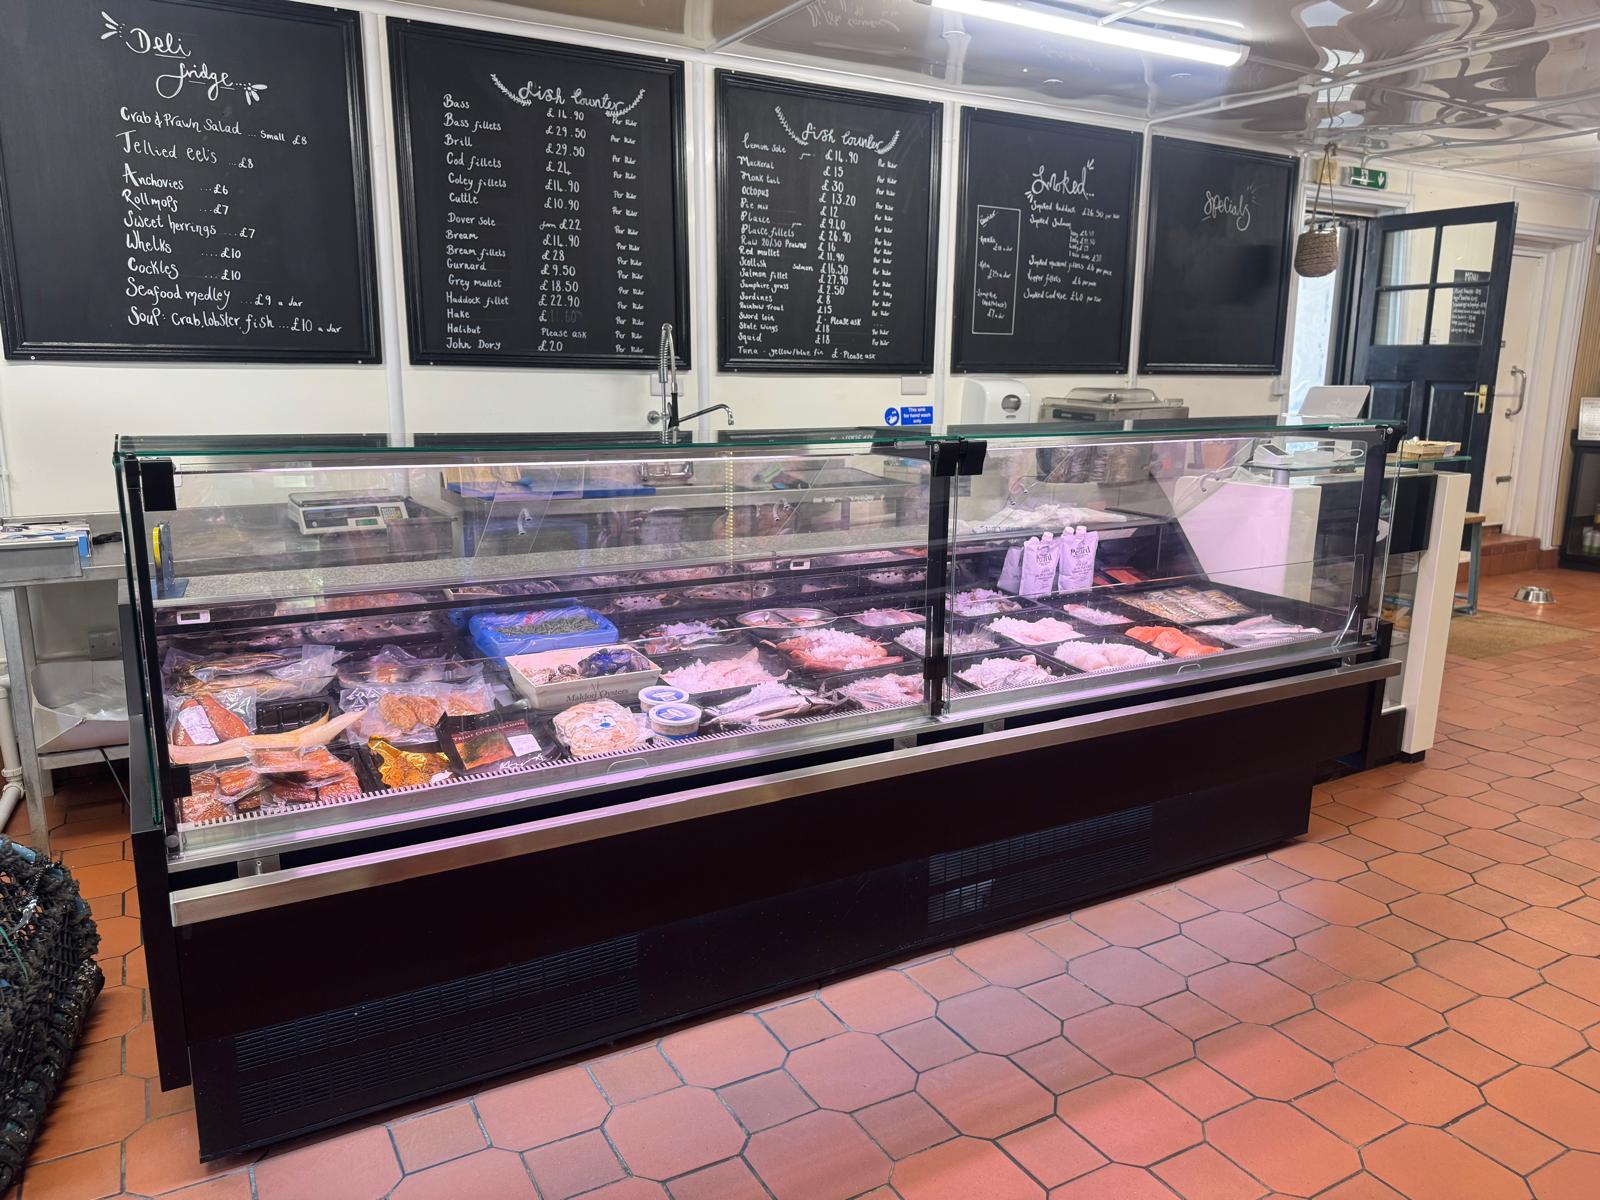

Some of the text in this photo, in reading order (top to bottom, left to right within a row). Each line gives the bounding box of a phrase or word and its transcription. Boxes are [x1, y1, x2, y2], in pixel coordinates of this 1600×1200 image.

[126, 28, 191, 56] Deli
[443, 94, 469, 109] Bass
[121, 107, 151, 123] Crab
[163, 113, 201, 132] Prawn
[203, 119, 242, 134] Salad
[292, 135, 307, 145] £8
[443, 112, 469, 127] Bass
[472, 121, 501, 132] fillets
[116, 130, 177, 158] Jellied
[444, 134, 472, 147] Brill
[447, 152, 464, 165] Cod
[467, 156, 501, 170] fillets
[122, 163, 184, 190] Anchovies
[448, 172, 473, 191] Coley
[474, 178, 506, 194] fillets
[449, 193, 478, 204] Cuttle
[124, 210, 163, 228] Sweet
[168, 214, 216, 238] herrings
[448, 212, 475, 224] Dover
[126, 230, 171, 253] Whelks
[446, 230, 478, 239] Bream
[446, 245, 476, 255] Bream
[477, 248, 505, 261] fillets
[128, 257, 178, 279] Cockles
[447, 258, 486, 270] Gurnard
[448, 274, 469, 291] Grey
[126, 277, 183, 305] Seafood
[185, 286, 230, 310] medley
[446, 291, 480, 304] Haddock
[483, 296, 509, 308] fillet
[447, 308, 470, 318] Hake
[242, 314, 274, 334] fish
[447, 323, 480, 334] Halibut
[541, 327, 568, 337] Please
[446, 337, 472, 349] John
[478, 339, 501, 350] Dory
[599, 688, 629, 699] Oysters
